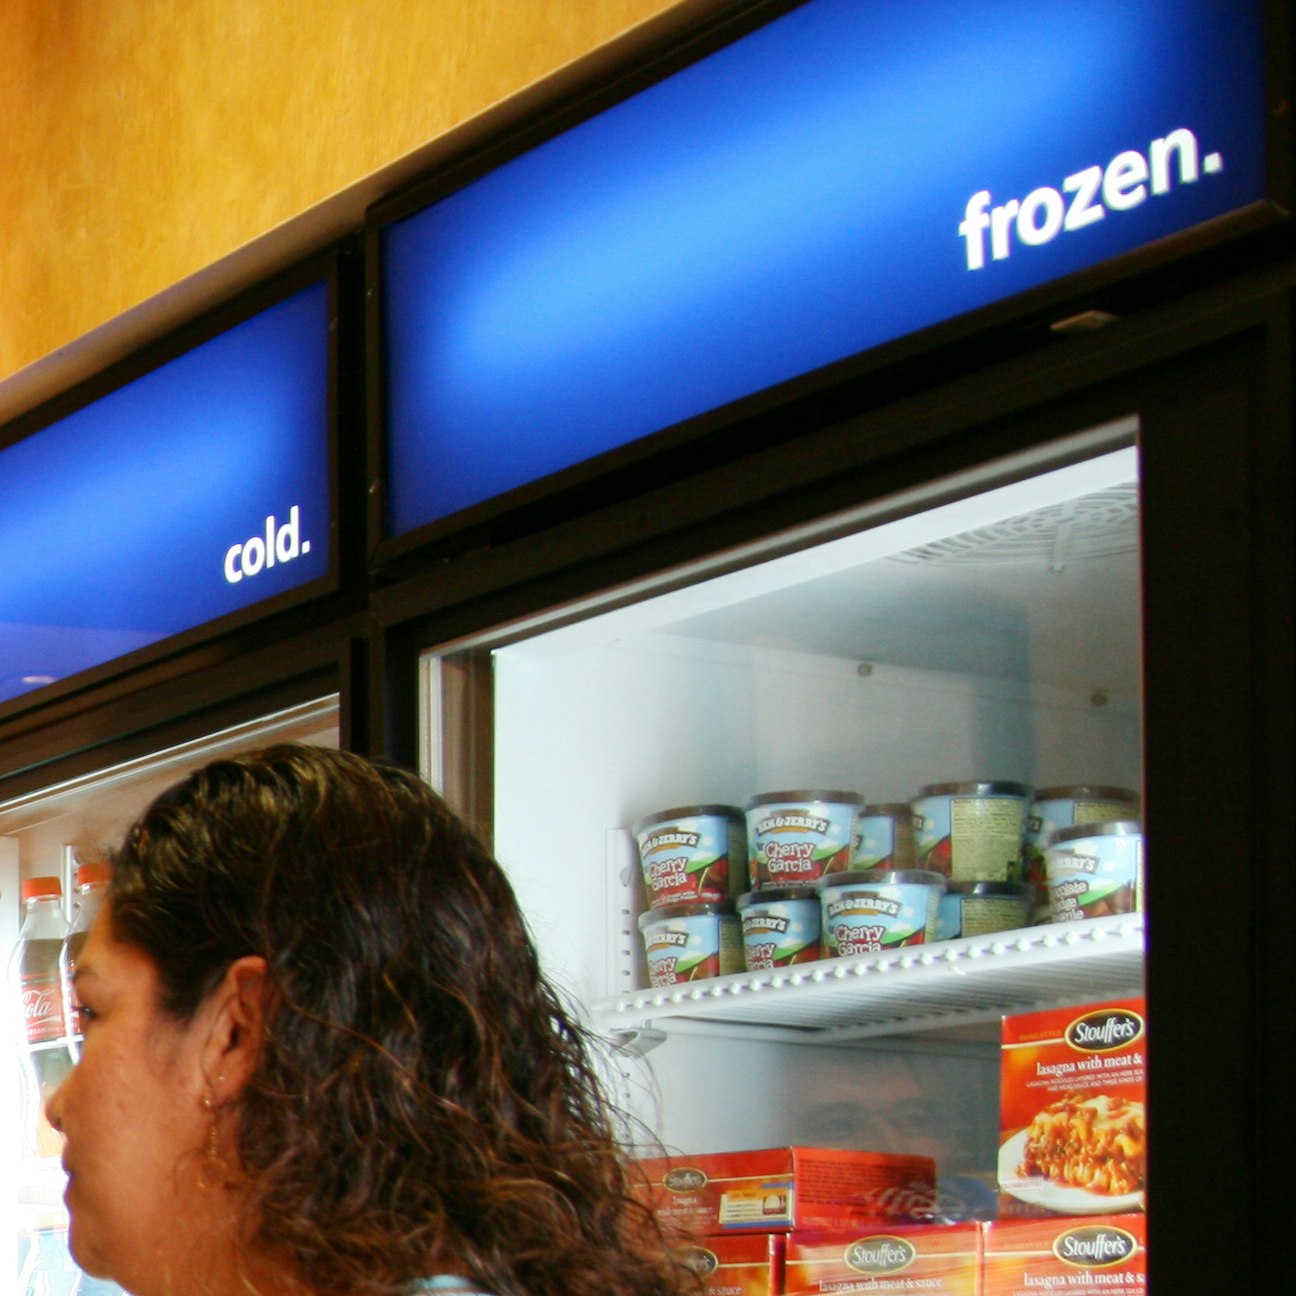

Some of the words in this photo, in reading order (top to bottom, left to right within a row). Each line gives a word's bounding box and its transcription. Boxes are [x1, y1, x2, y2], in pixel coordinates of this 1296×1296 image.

[959, 128, 1223, 272] frozen.
[224, 504, 311, 584] cold.
[765, 841, 815, 859] Cherry
[648, 857, 689, 878] Cherry
[767, 858, 812, 873] Garcia
[651, 872, 688, 891] Garcia
[836, 924, 885, 941] Cherry
[1074, 1017, 1135, 1043] Stouffer's
[1036, 1061, 1075, 1077] lasagna
[1077, 1055, 1102, 1071] with
[1104, 1056, 1131, 1067] meat
[1133, 1053, 1143, 1065] &
[853, 1243, 907, 1267] Stouffer's
[1063, 1233, 1127, 1259] Stouffer's
[819, 1280, 855, 1295] lasagna
[857, 1277, 878, 1292] with
[879, 1279, 905, 1290] meat
[906, 1279, 913, 1289] &
[915, 1279, 942, 1289] sauce
[1024, 1272, 1066, 1288] lasagna
[1067, 1271, 1093, 1286] with
[1095, 1273, 1123, 1285] meat
[1125, 1272, 1134, 1283] &
